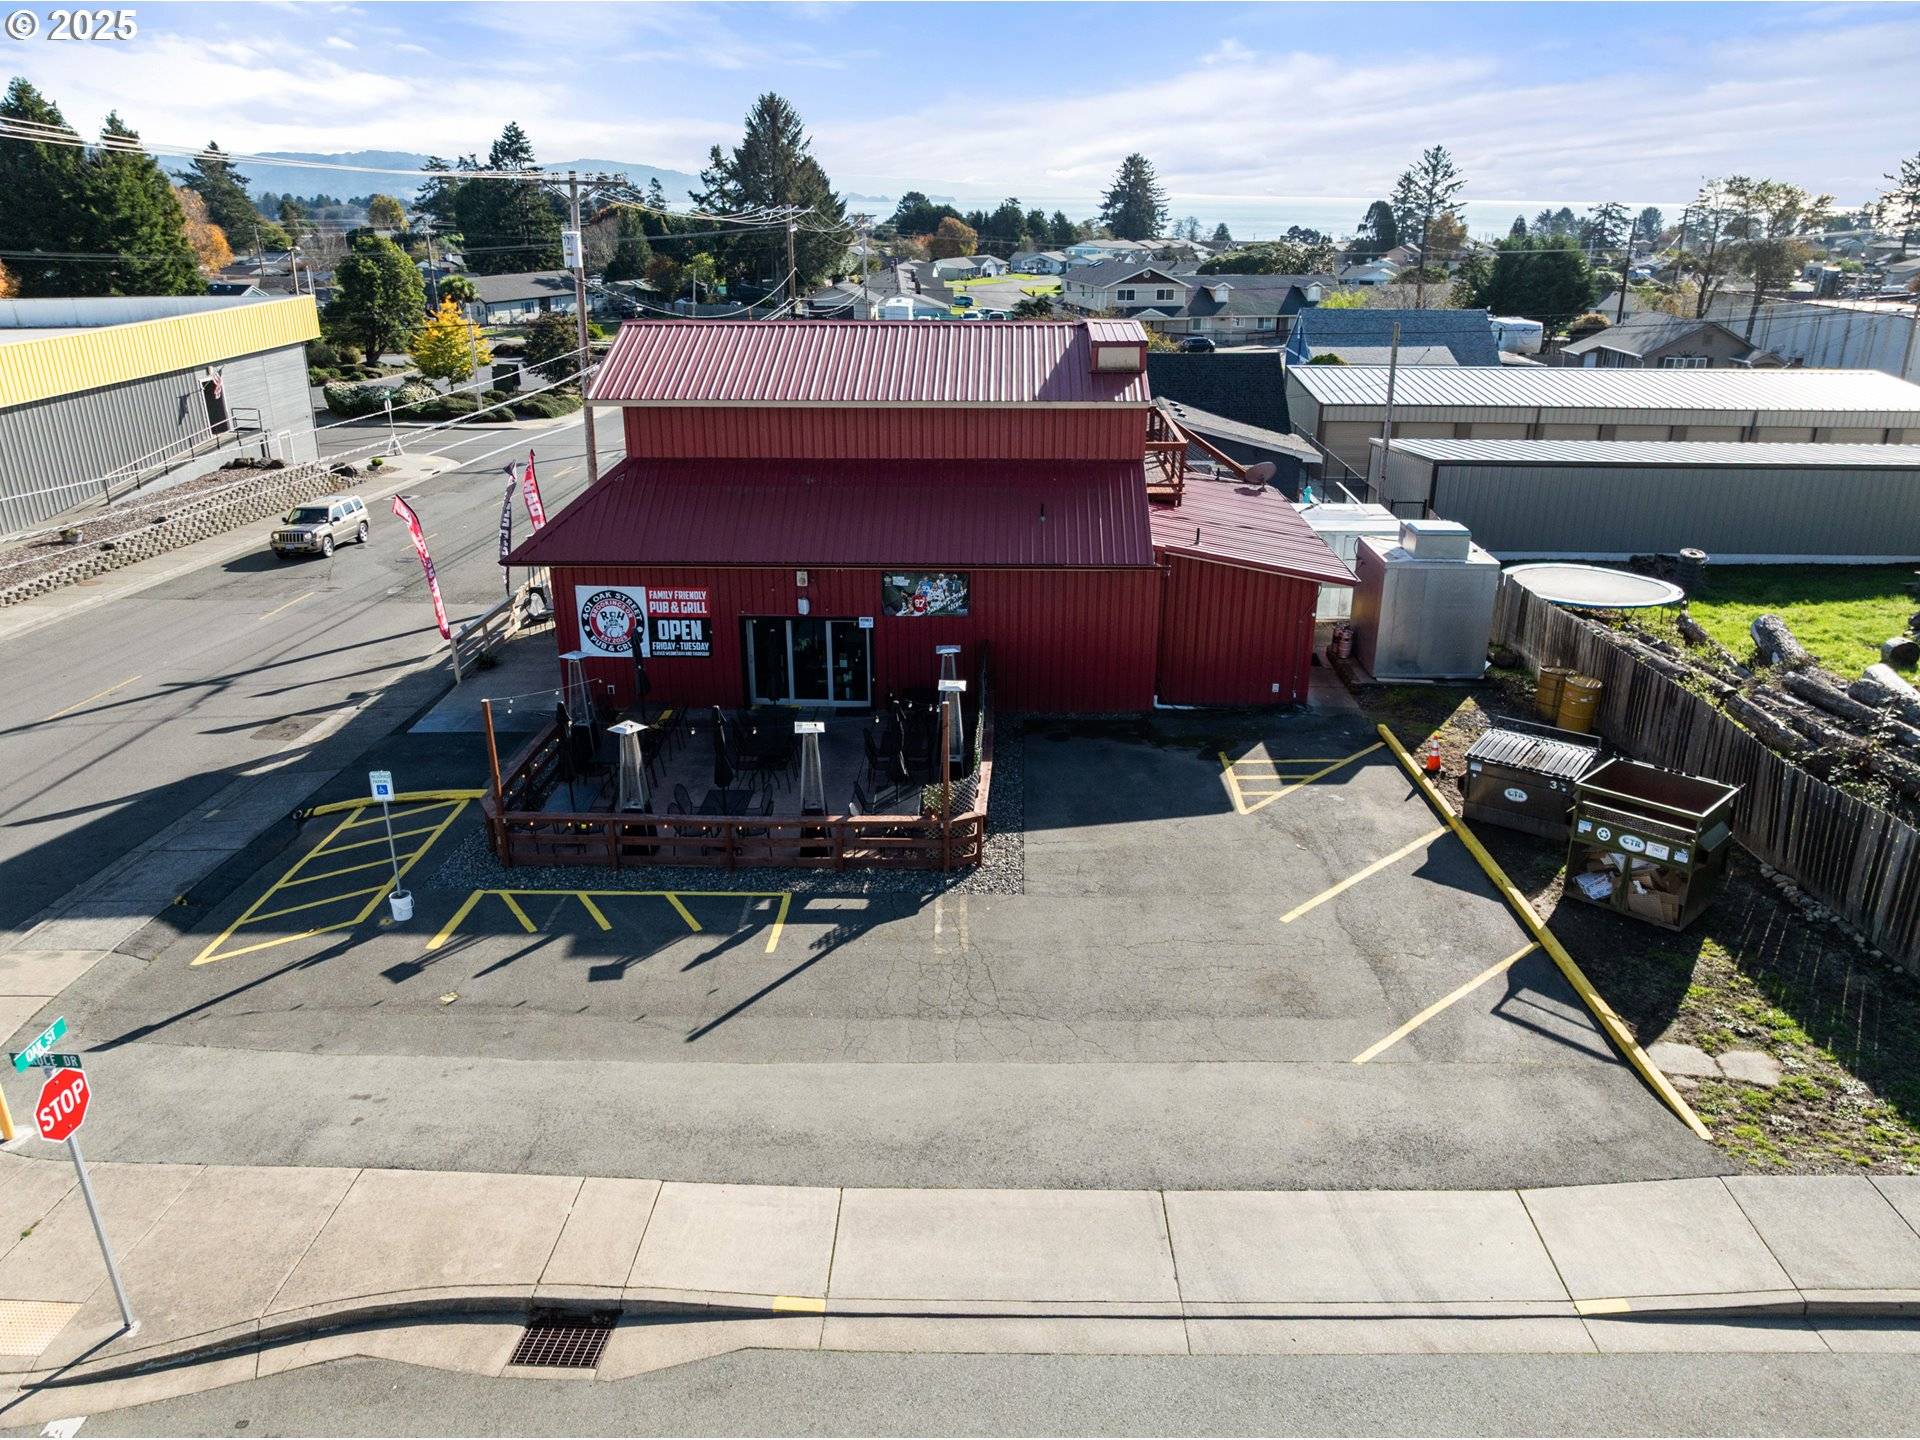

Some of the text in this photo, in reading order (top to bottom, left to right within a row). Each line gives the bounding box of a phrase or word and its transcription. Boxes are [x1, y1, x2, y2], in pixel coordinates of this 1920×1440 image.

[648, 590, 707, 600] FAMILY FRIENDLY
[582, 591, 643, 621] 401 OAK STREET
[649, 601, 708, 614] PUB & GRILL
[657, 619, 703, 641] OPEN
[590, 635, 607, 650] PUB
[616, 641, 633, 651] GRI
[652, 641, 676, 651] FRIDAY
[680, 641, 710, 651] TUESDAY
[1622, 837, 1642, 849] CTR
[25, 1027, 56, 1062] OAK ST
[63, 1055, 79, 1067] DR
[39, 1078, 84, 1132] STOP
